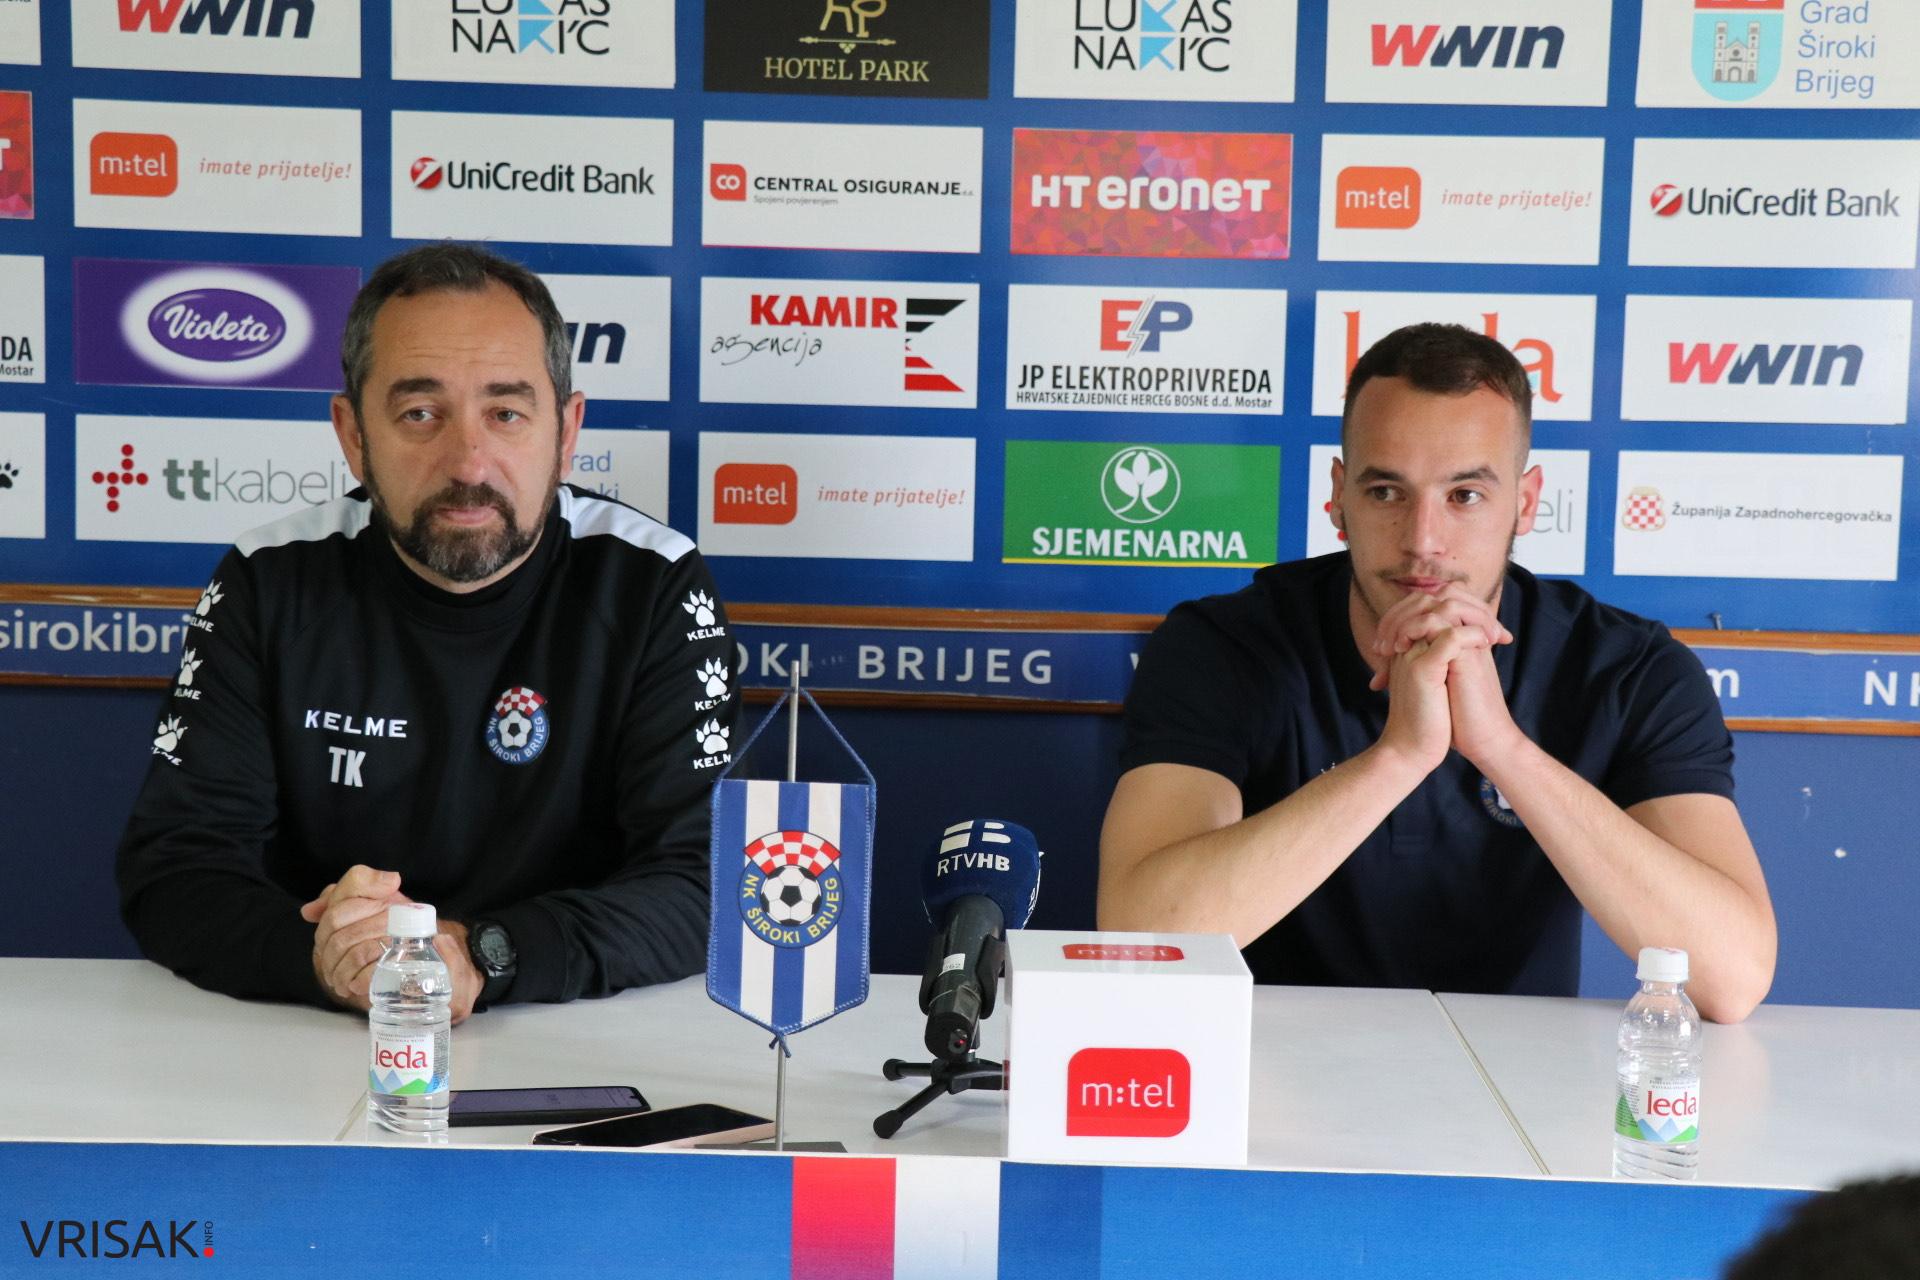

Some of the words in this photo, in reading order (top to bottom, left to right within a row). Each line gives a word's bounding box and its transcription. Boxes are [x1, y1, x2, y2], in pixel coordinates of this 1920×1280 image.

[1074, 0, 1232, 34] LUKAS
[1801, 0, 1868, 24] Grad
[1797, 29, 1876, 58] Široki
[764, 57, 852, 80] HOTEL
[860, 60, 930, 82] PARK
[1795, 69, 1874, 99] Brijeg
[100, 152, 168, 178] m:tel
[199, 158, 251, 175] imate
[257, 158, 352, 183] prijatelje!
[448, 161, 575, 193] UniCredit
[584, 165, 654, 195] Bank
[754, 176, 838, 193] CENTRAL
[844, 179, 960, 196] OSIGURANJE
[1031, 174, 1091, 208] HT
[1345, 185, 1411, 210] m:tel
[1442, 189, 1493, 206] imate
[1498, 189, 1592, 211] prijatelje!
[1688, 187, 1817, 217] UniCredit
[1826, 188, 1900, 217] Bank
[164, 304, 271, 342] Violeta
[750, 294, 898, 328] KAMIR
[1018, 364, 1044, 389] JP
[1052, 365, 1272, 394] ELEKTROPRIVREDA
[1016, 392, 1069, 404] HRVATSKE
[1072, 393, 1128, 406] ZAJEDNICE
[1131, 394, 1172, 407] HERCEG
[1174, 394, 1209, 407] BOSNE
[1235, 396, 1272, 408] Mostar
[570, 450, 612, 473] rad
[723, 481, 788, 505] m:tel
[817, 486, 868, 503] imate
[874, 488, 966, 509] prijatelje!
[1672, 501, 1731, 519] Županija
[1735, 506, 1893, 524] Zapadnohercegovačka
[1032, 527, 1248, 559] SJEMENARNA
[687, 627, 726, 641] KELME
[858, 644, 1053, 684] BRIJEG
[304, 709, 408, 738] KELME
[524, 716, 545, 757] BRIJEG
[329, 746, 367, 788] TK
[937, 851, 1010, 877] RTVHB
[743, 874, 760, 899] NK
[807, 877, 840, 939] BRIJEG
[747, 907, 801, 944] ŠIROKI
[375, 1042, 428, 1069] leda
[1081, 1075, 1175, 1109] m:tel
[1646, 1090, 1697, 1117] leda
